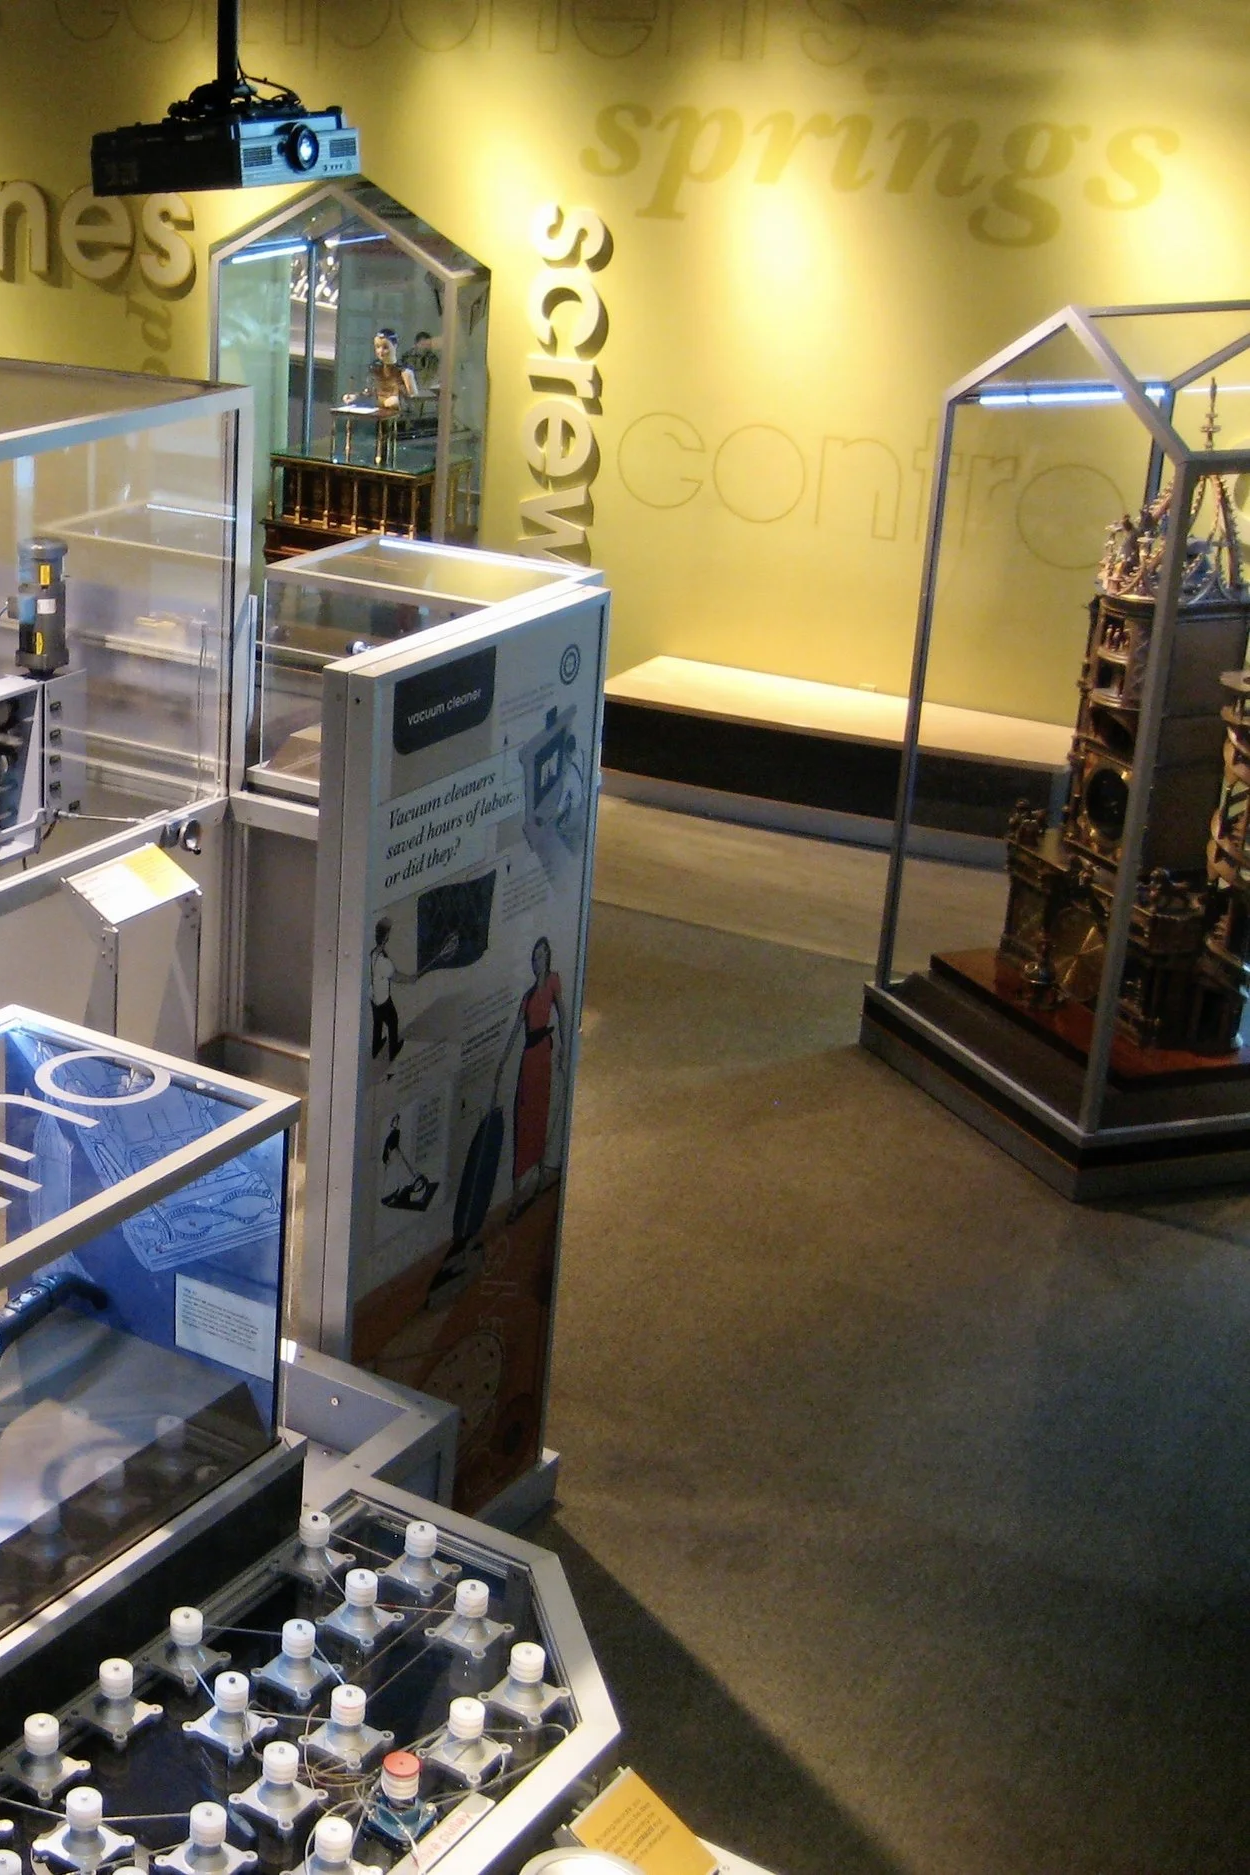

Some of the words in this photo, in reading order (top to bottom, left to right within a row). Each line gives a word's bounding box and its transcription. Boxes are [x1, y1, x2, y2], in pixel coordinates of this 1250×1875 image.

[579, 66, 1180, 248] springs
[406, 704, 446, 727] vacuum
[447, 687, 482, 712] cleaner
[388, 798, 442, 830] Vacuum
[443, 772, 497, 803] cleaners
[385, 824, 424, 859] saved
[426, 813, 463, 839] hours
[465, 803, 482, 828] of
[384, 870, 401, 888] or
[402, 855, 426, 881] did
[427, 837, 462, 871] they?
